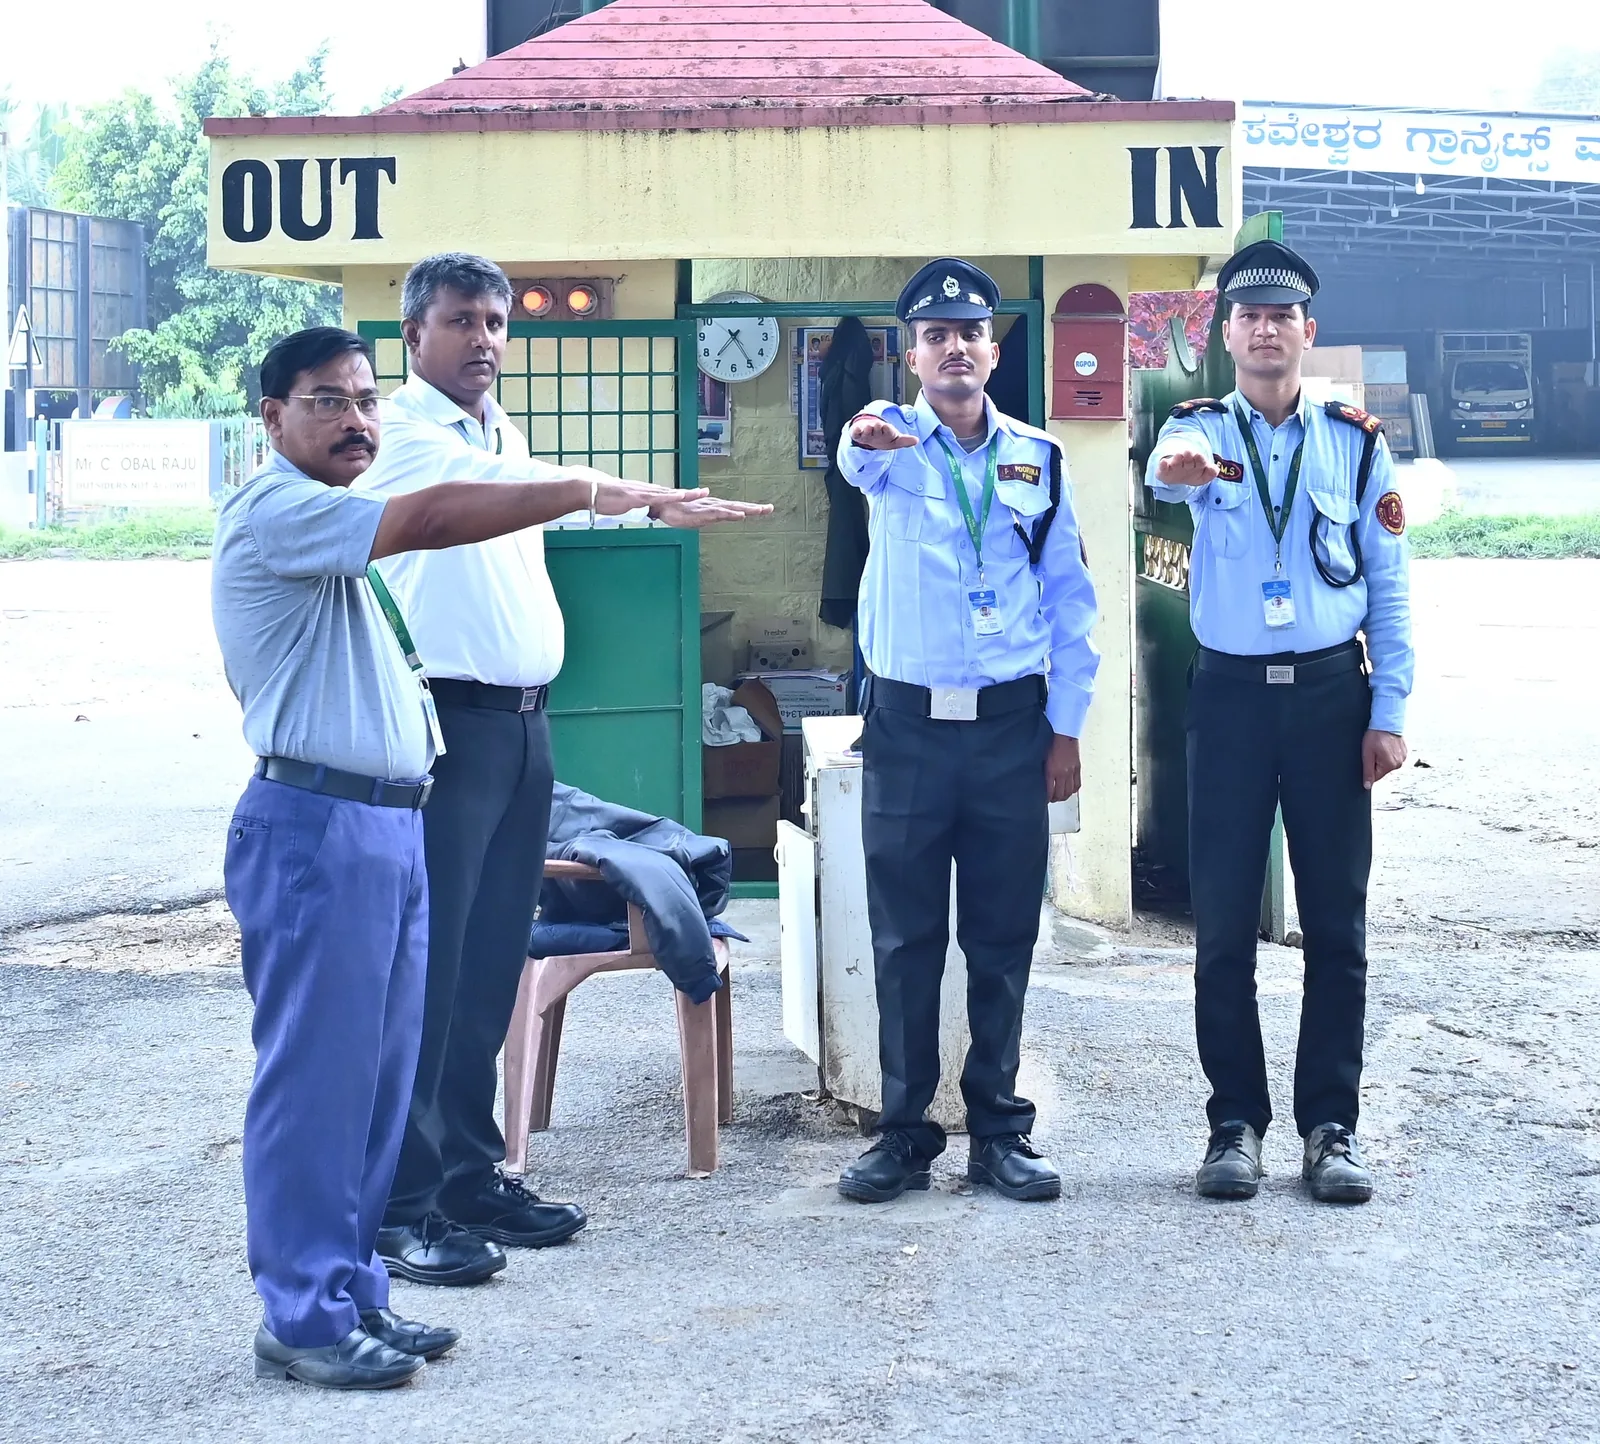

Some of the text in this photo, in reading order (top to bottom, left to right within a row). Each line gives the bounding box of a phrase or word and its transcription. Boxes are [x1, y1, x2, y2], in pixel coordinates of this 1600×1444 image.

[1125, 146, 1225, 229] IN
[222, 157, 396, 243] OUT
[702, 317, 713, 326] 10
[757, 317, 765, 326] 2
[698, 333, 706, 342] 9
[761, 332, 769, 342] 3
[703, 348, 710, 357] 8
[757, 348, 764, 357] 4
[714, 359, 722, 369] 7
[730, 363, 737, 373] 6
[746, 359, 754, 369] 5
[1075, 360, 1096, 368] RGPOA
[162, 457, 197, 471] RAJU
